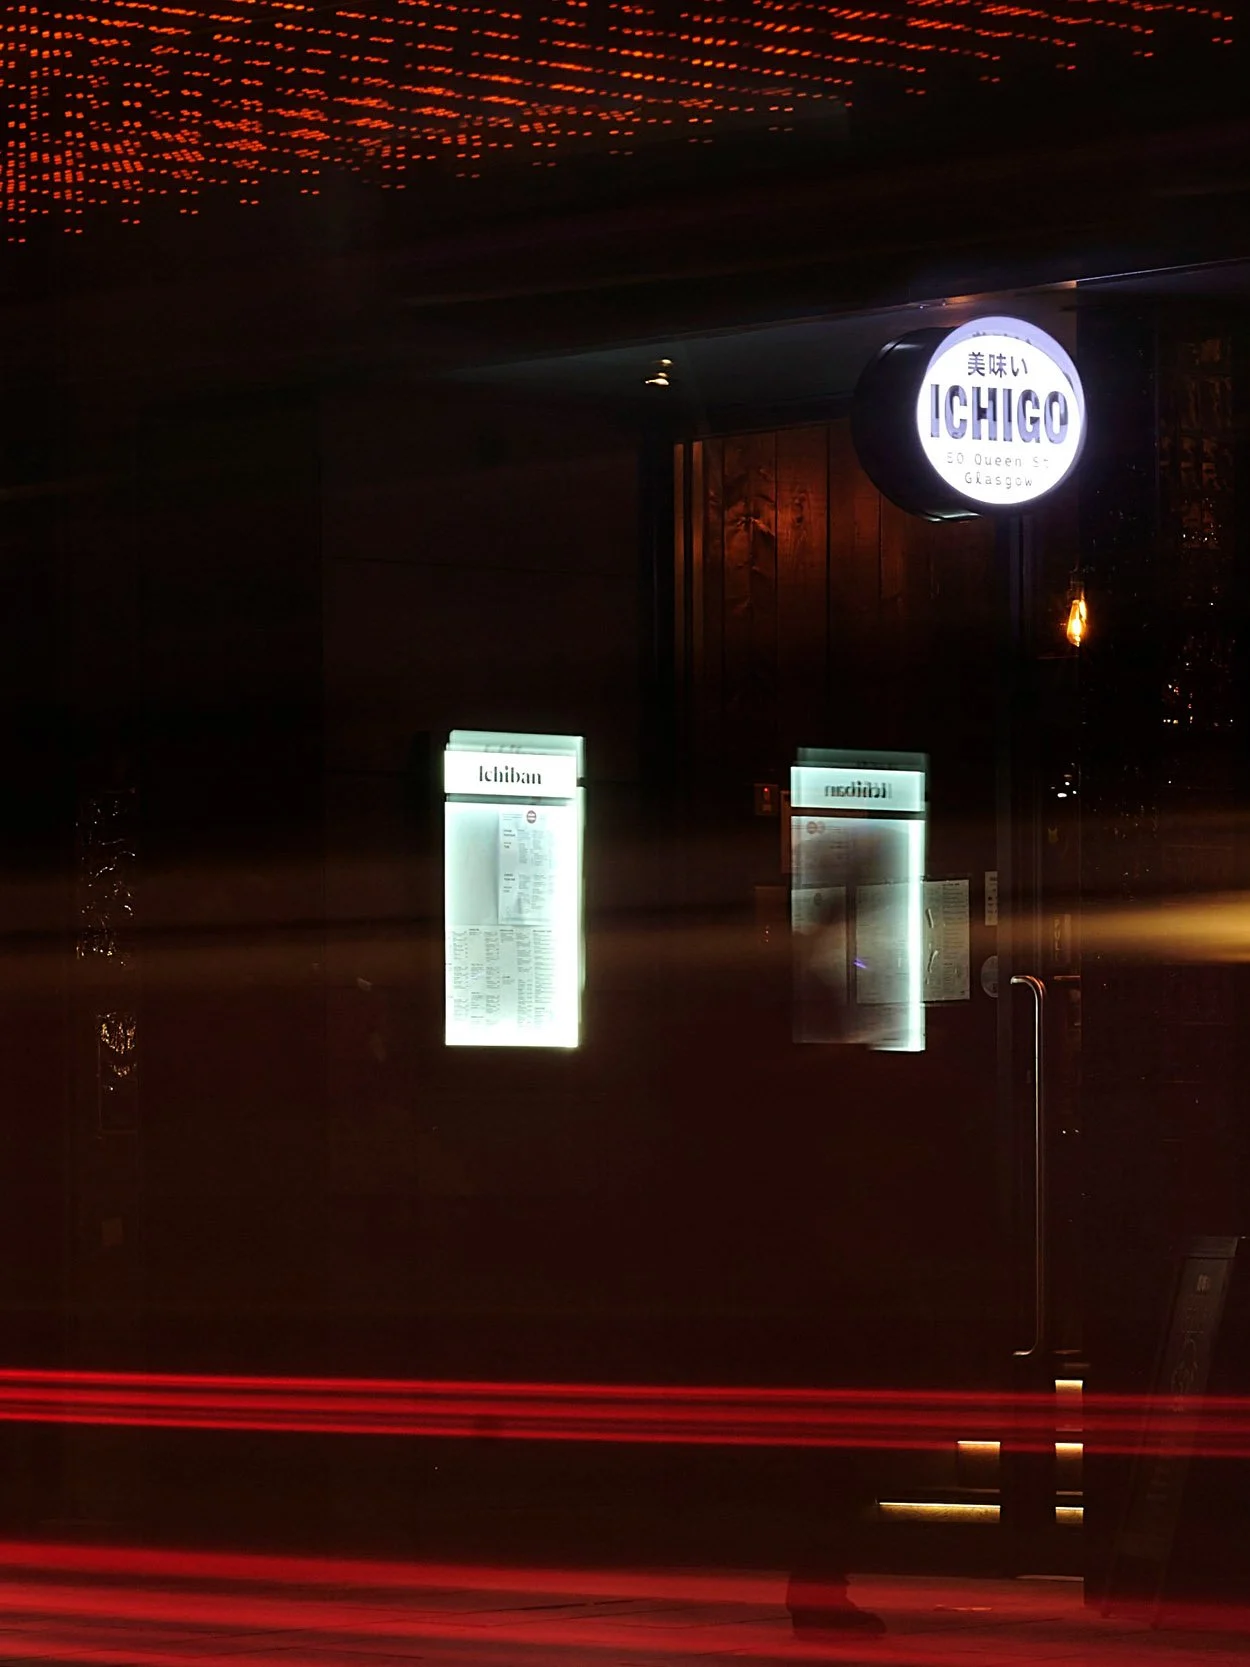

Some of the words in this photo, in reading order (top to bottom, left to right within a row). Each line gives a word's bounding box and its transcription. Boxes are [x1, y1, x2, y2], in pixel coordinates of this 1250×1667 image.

[967, 351, 1029, 378] 美味い
[930, 384, 1069, 444] ICHIGO
[974, 453, 1022, 467] Queen
[964, 471, 1033, 489] Glasgow
[478, 765, 542, 785] Ichiban
